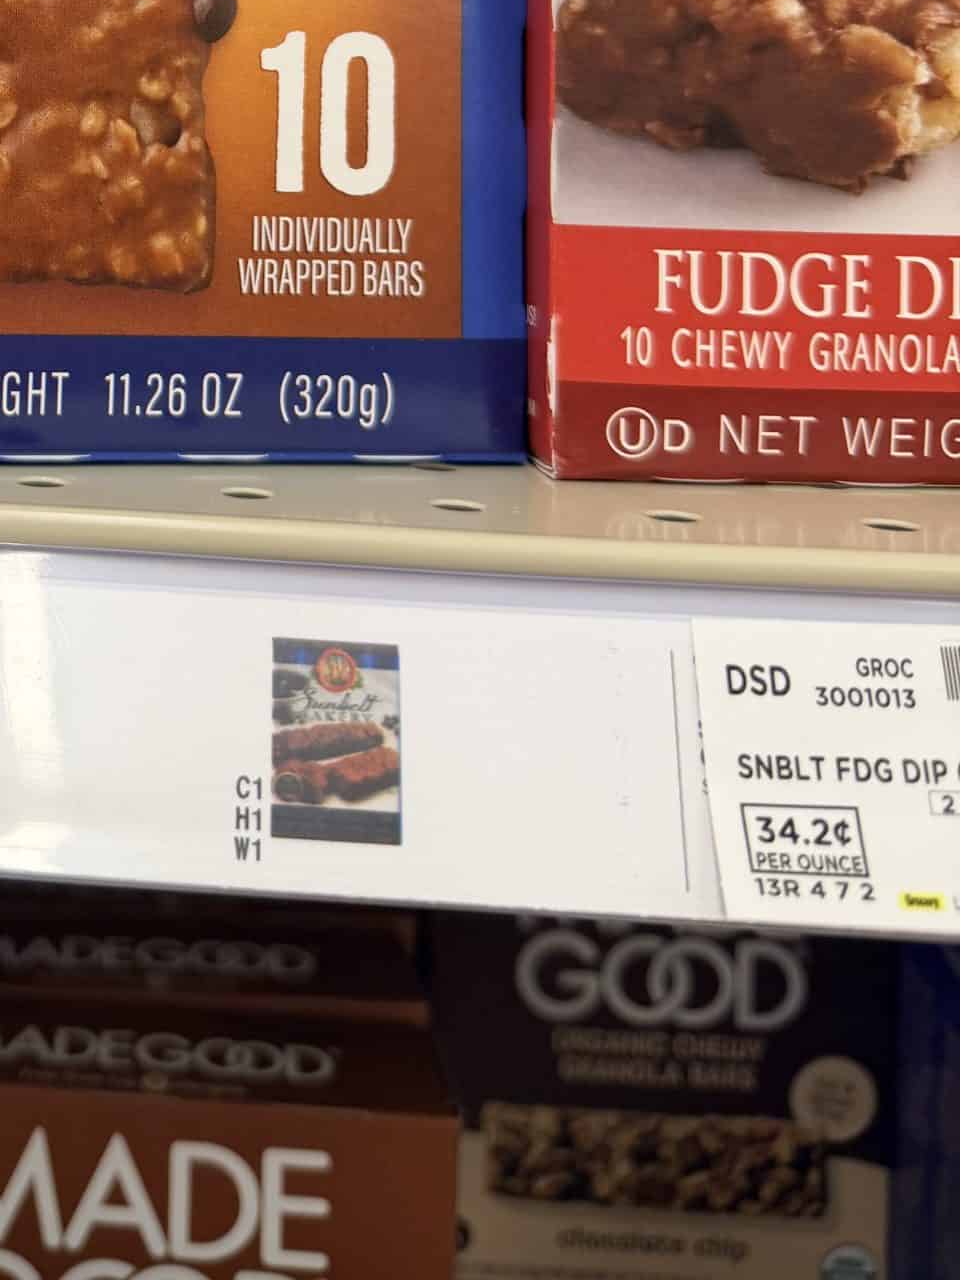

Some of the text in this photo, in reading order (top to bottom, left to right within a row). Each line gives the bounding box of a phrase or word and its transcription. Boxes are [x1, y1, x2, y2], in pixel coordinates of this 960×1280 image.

[259, 30, 396, 197] 10
[252, 215, 413, 255] INDIVIDUALLY
[238, 257, 425, 298] WRAPPED BARS
[653, 248, 873, 320] FUDGE
[619, 325, 960, 376] 10 CHEWY GRANOLA
[102, 371, 190, 418] 11.26
[200, 373, 245, 418] OZ
[277, 371, 396, 430] (320g)
[718, 413, 818, 458] NET
[724, 664, 791, 697] DSD
[854, 657, 915, 680] GROC
[814, 686, 917, 710] 3001013
[737, 753, 948, 785] SNBLT FDG DIP
[235, 775, 263, 801] C1
[235, 806, 262, 832] H1
[941, 794, 956, 816] 2
[754, 815, 852, 848] 34.2¢
[234, 836, 262, 862] W1
[755, 851, 864, 874] PER OUNCE
[754, 876, 876, 902] 13R 4 7 2
[514, 926, 809, 1031] GOOD
